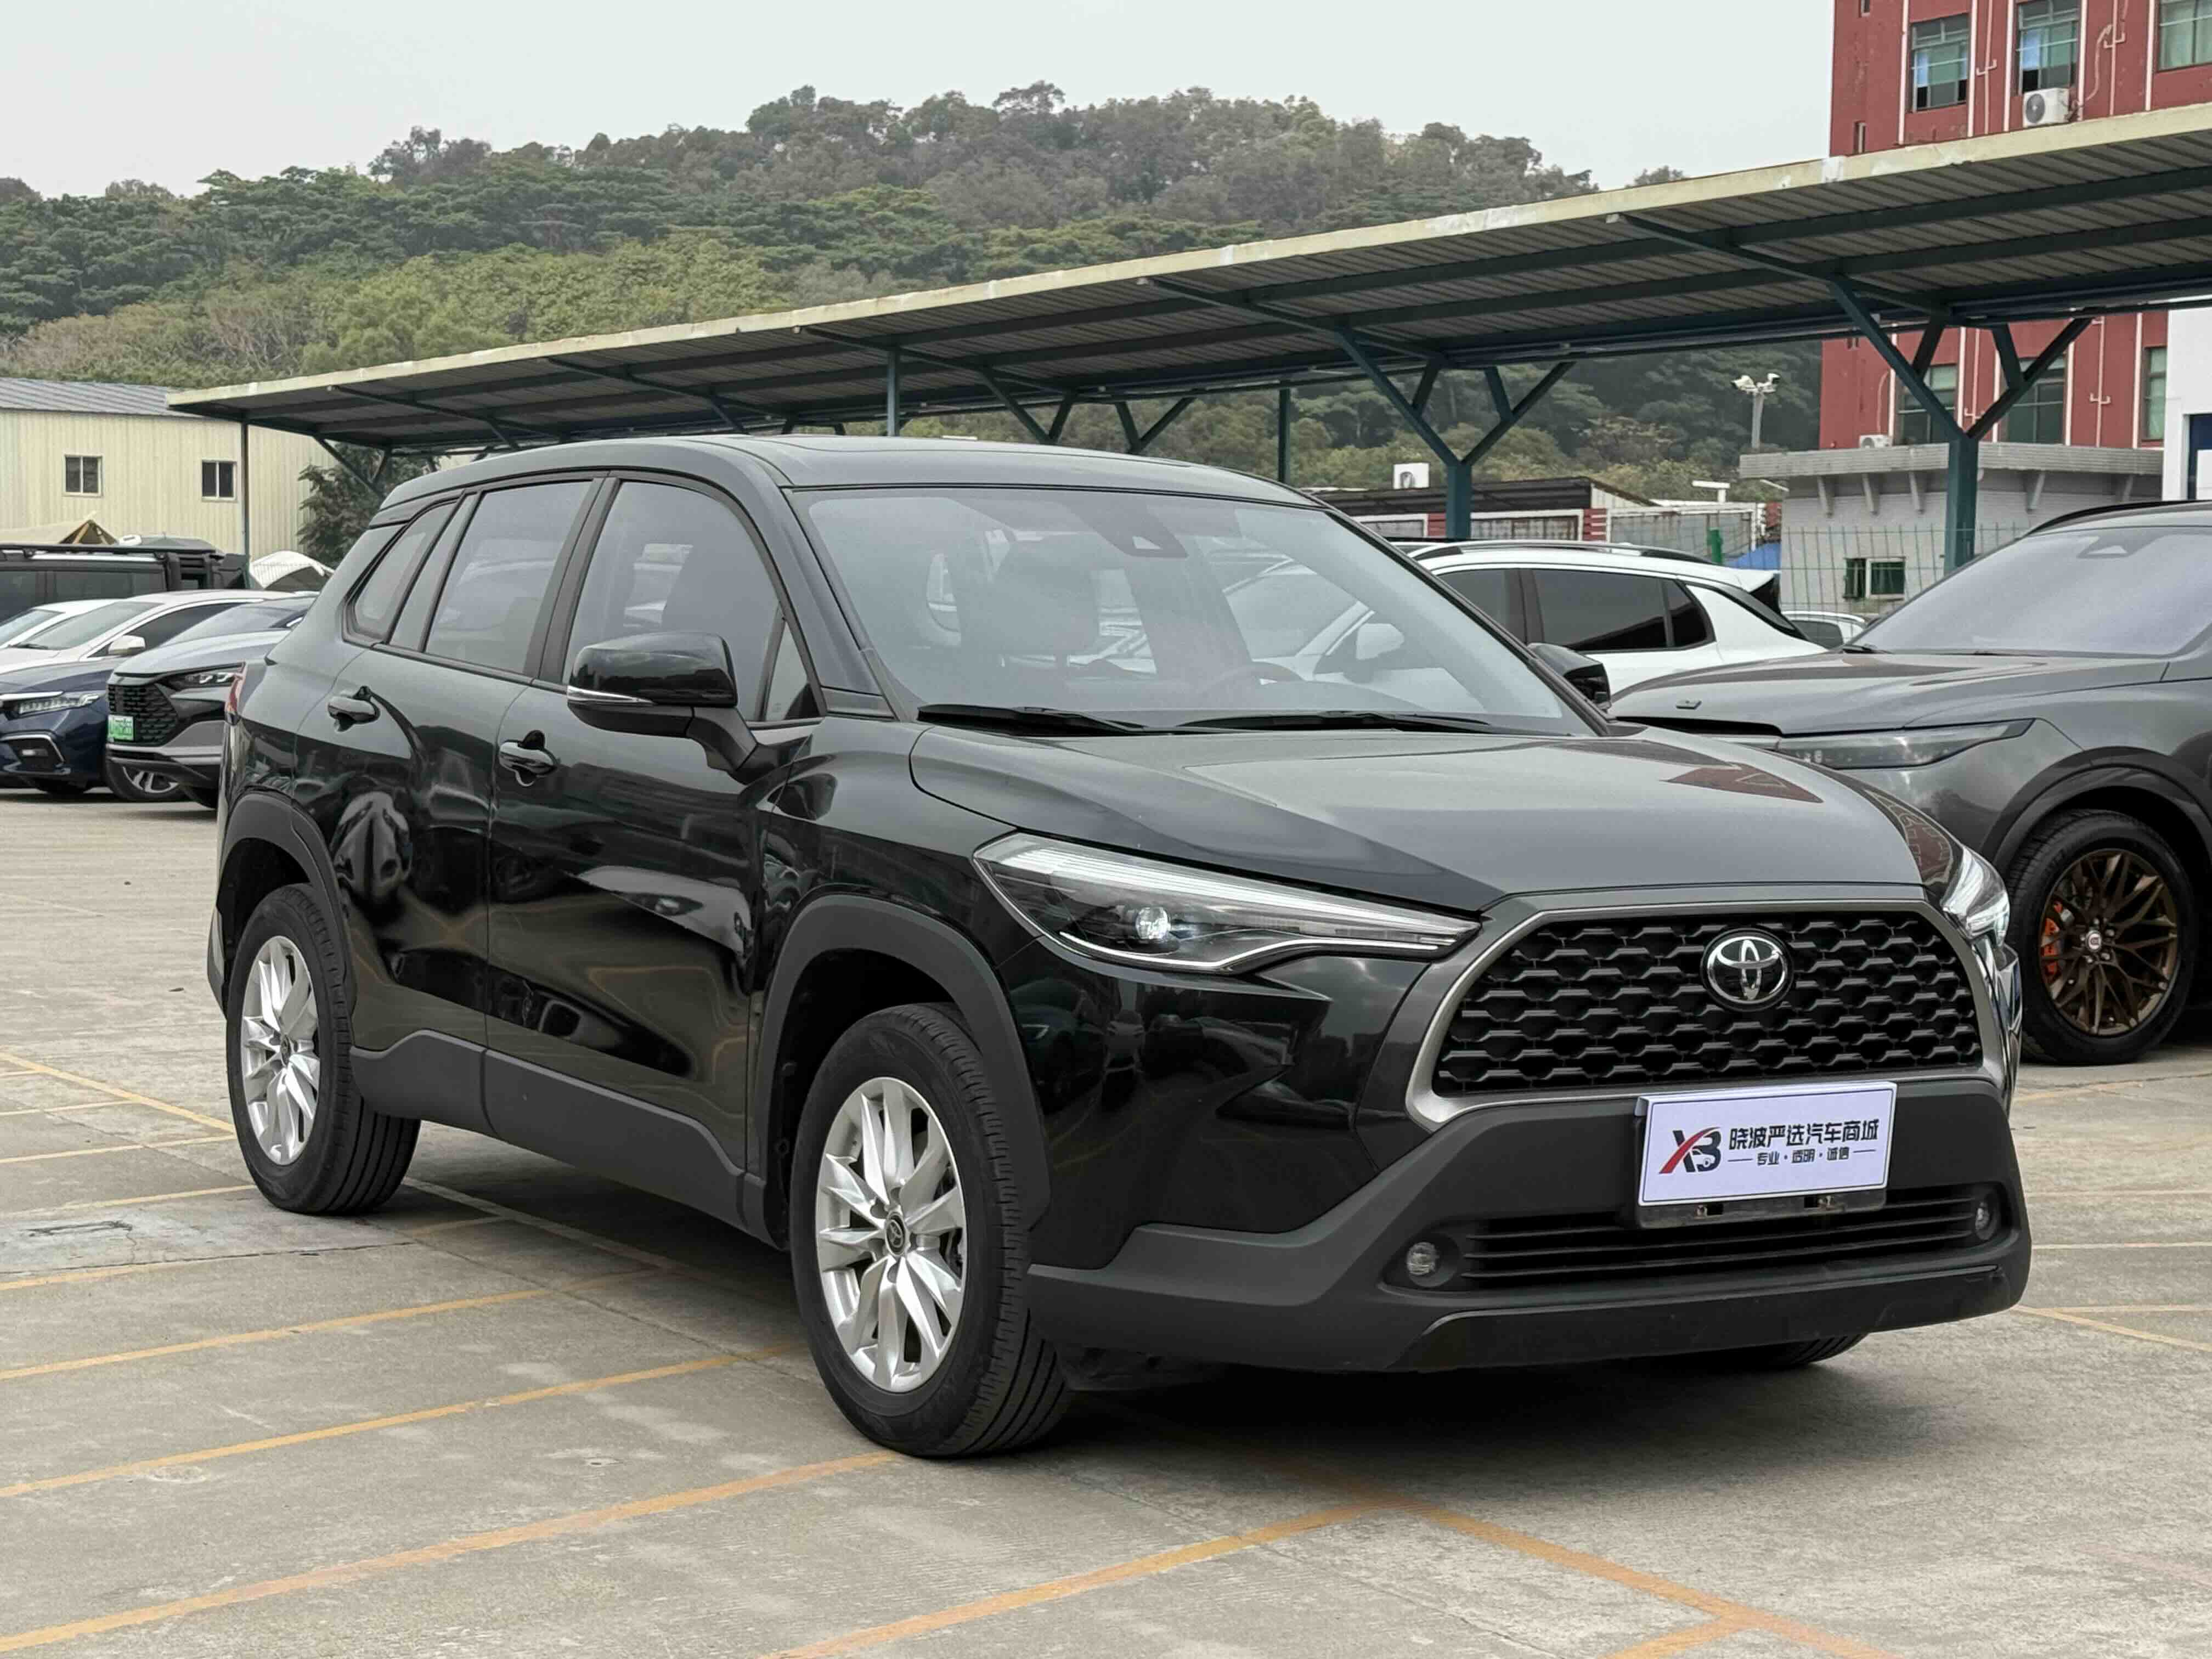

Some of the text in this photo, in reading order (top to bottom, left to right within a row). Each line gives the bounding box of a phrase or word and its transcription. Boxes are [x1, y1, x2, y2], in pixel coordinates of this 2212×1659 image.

[1729, 1119, 1879, 1150] 晓波严选汽车商城
